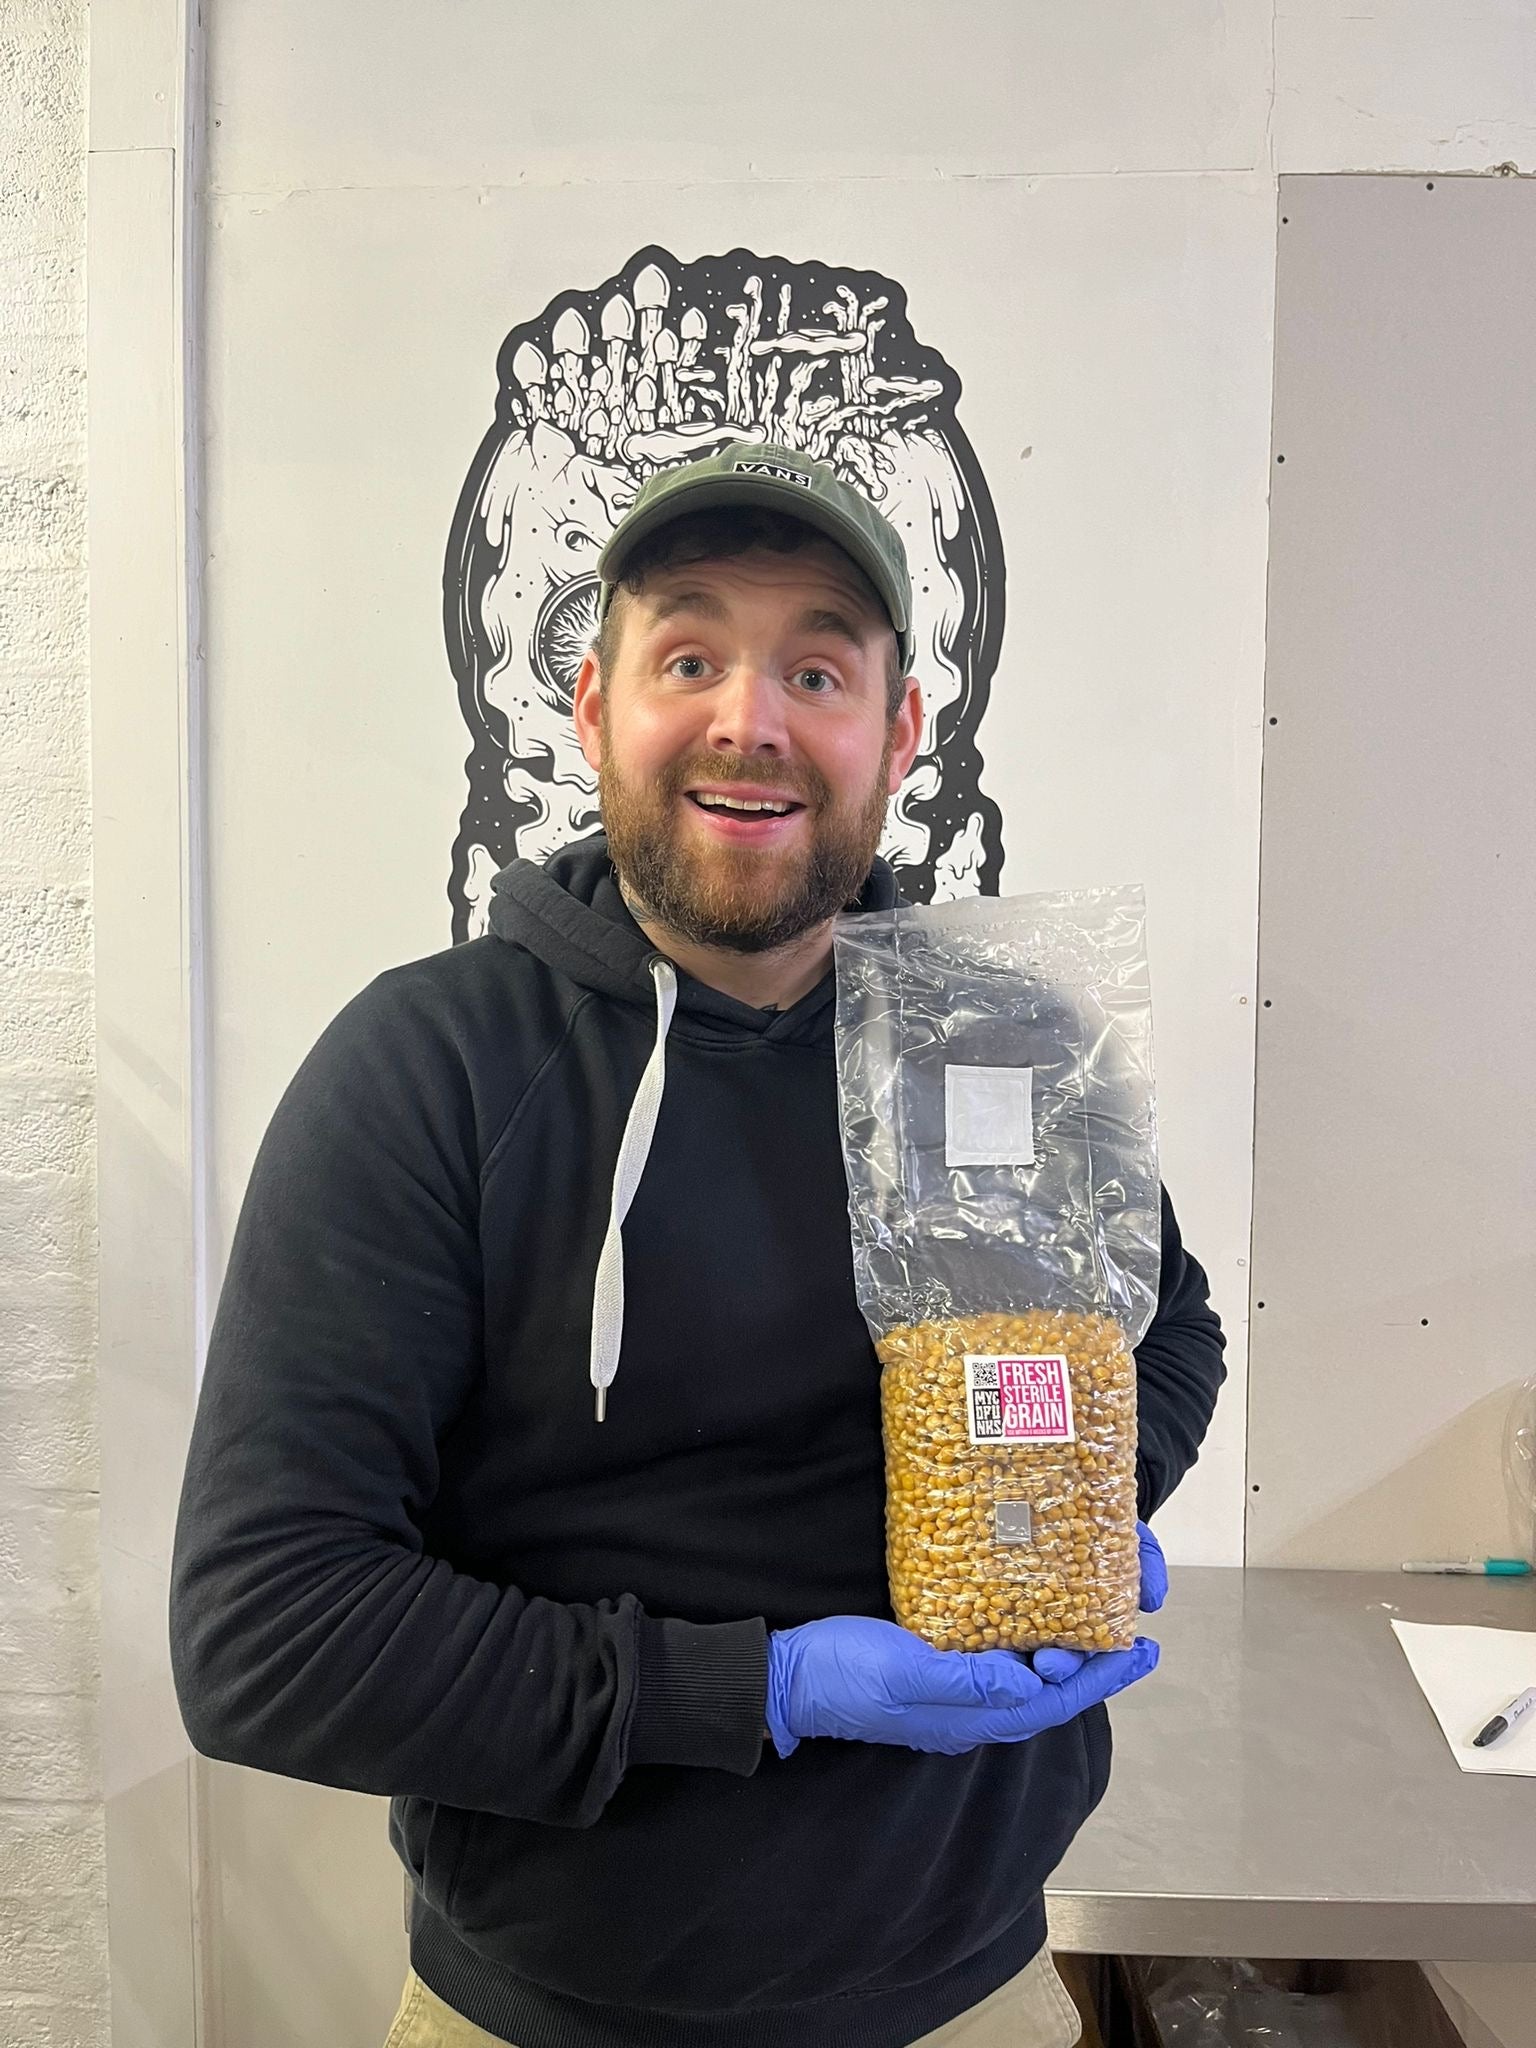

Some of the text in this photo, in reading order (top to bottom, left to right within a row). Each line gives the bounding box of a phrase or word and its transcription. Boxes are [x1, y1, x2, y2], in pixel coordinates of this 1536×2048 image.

[741, 464, 806, 485] VANS
[1001, 1362, 1060, 1385] FRESH
[975, 1391, 1000, 1405] MYC
[1003, 1385, 1062, 1404] STERILE
[1005, 1403, 1065, 1429] GRAIN
[976, 1420, 1002, 1435] NKS
